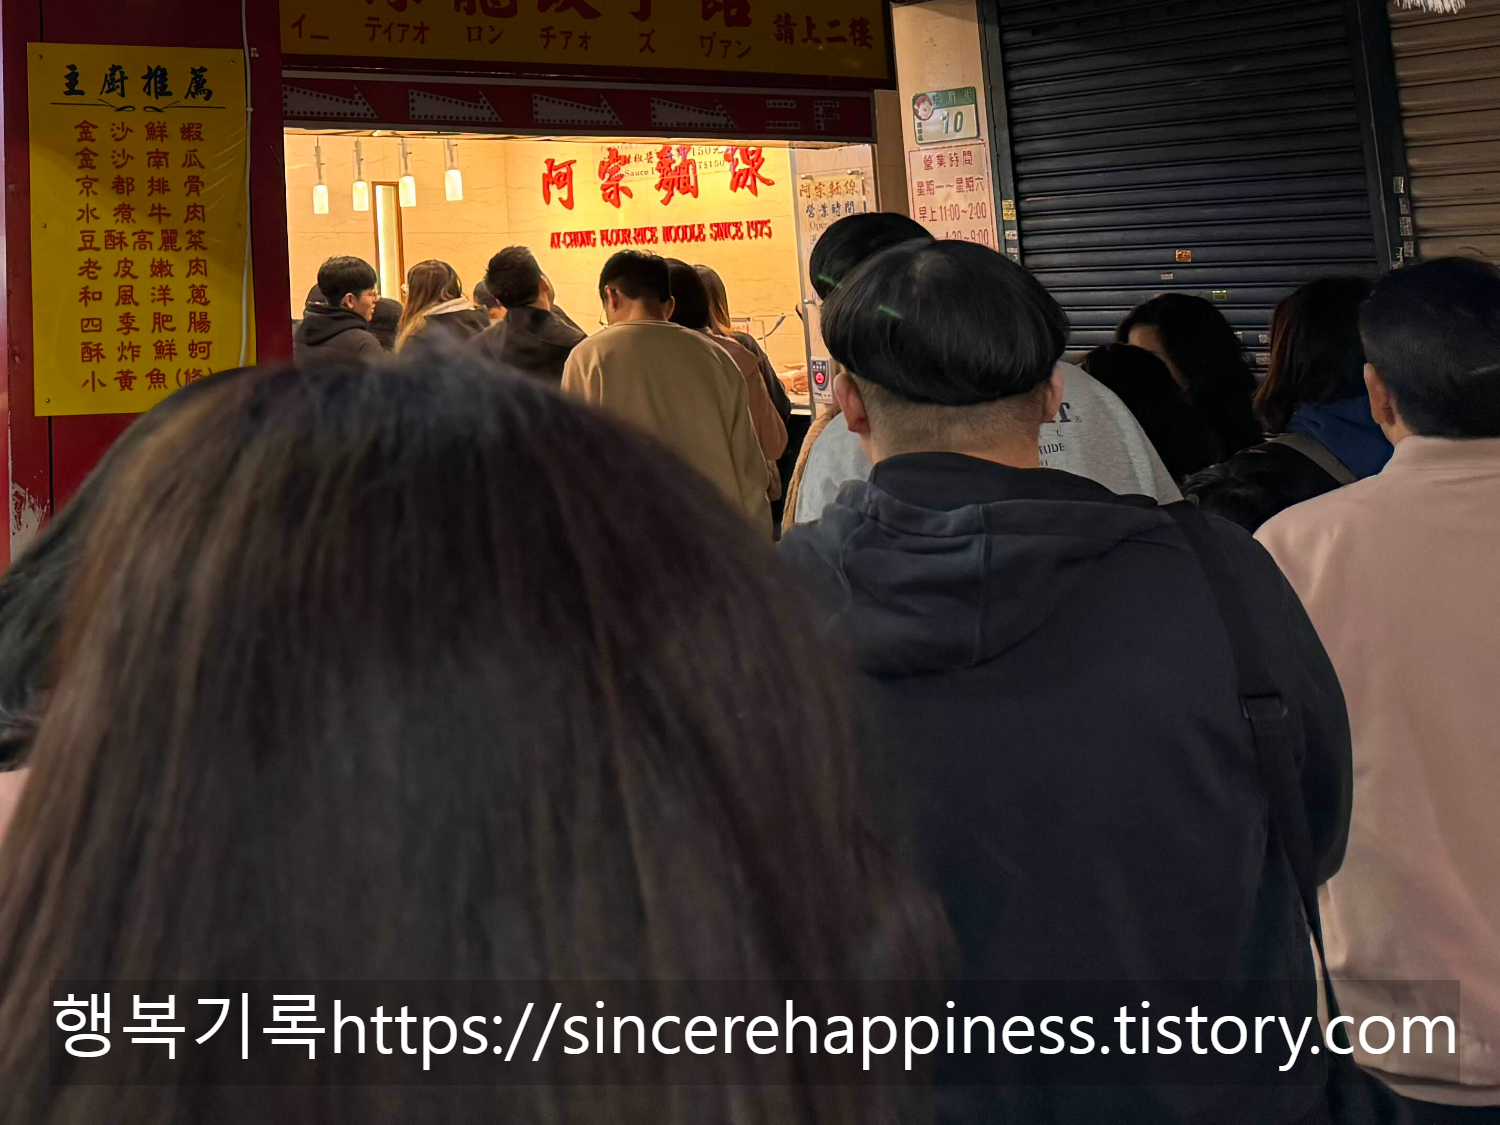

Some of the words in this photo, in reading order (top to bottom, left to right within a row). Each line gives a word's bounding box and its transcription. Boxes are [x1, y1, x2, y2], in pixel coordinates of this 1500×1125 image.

[62, 63, 214, 102] 主廚推薦
[74, 119, 205, 143] 金沙鮮蝦
[941, 110, 964, 135] 10
[74, 146, 206, 170] 金沙南瓜
[75, 174, 205, 198] 京都排骨
[76, 202, 206, 225] 水煮牛肉
[77, 228, 209, 253] 豆酥高麗菜
[662, 223, 706, 245] NOODLE
[710, 220, 744, 241] SINCE
[746, 218, 773, 240] 1975
[77, 256, 208, 281] 老皮嫩肉
[80, 311, 212, 336] 四季肥腸
[80, 338, 214, 364] 酥炸鮮蚵
